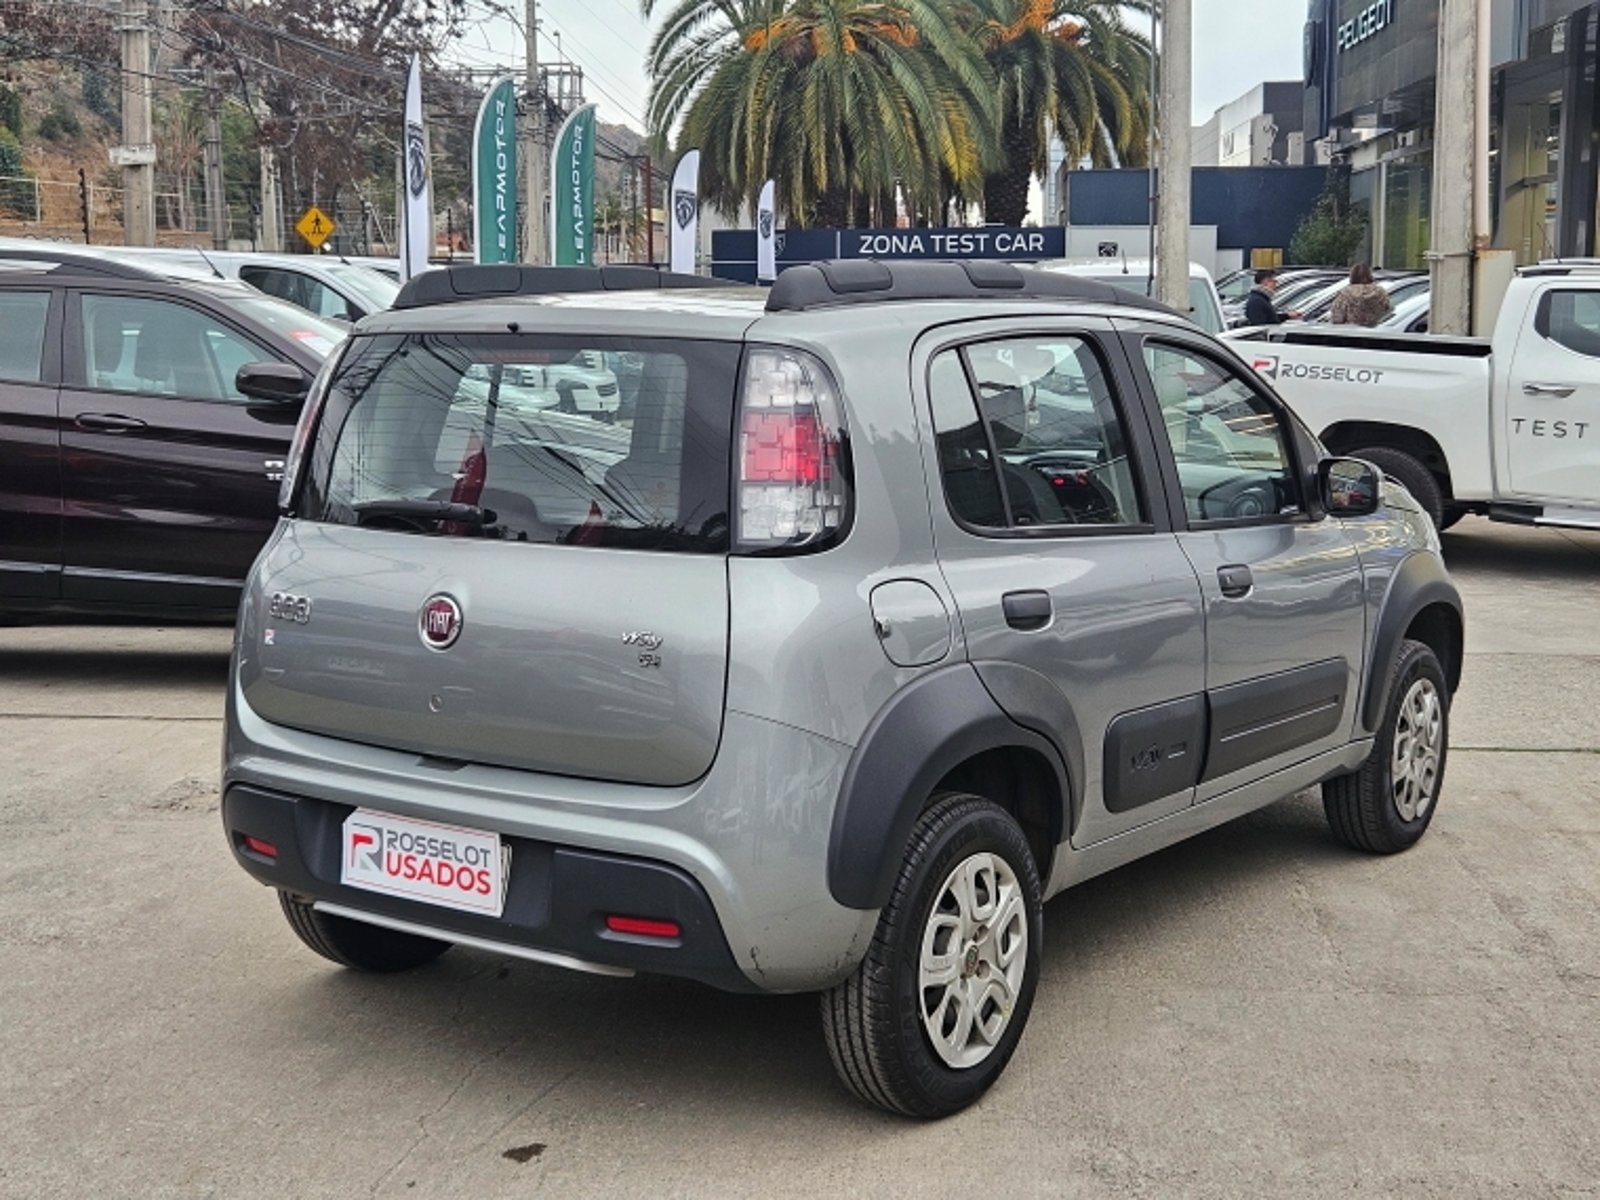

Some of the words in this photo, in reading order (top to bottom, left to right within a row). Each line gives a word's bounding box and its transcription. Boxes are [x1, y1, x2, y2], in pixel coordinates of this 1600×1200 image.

[495, 100, 508, 264] LEAPMOTOR
[571, 125, 586, 264] LEAPMOTOR
[858, 235, 924, 254] ZONA
[930, 234, 988, 252] TEST
[995, 233, 1044, 252] CAR
[1281, 363, 1383, 385] ROSSELOT
[1512, 418, 1589, 439] TEST
[428, 609, 452, 635] FIAT
[386, 829, 491, 868] ROSSELOT
[386, 851, 491, 896] USADOS
